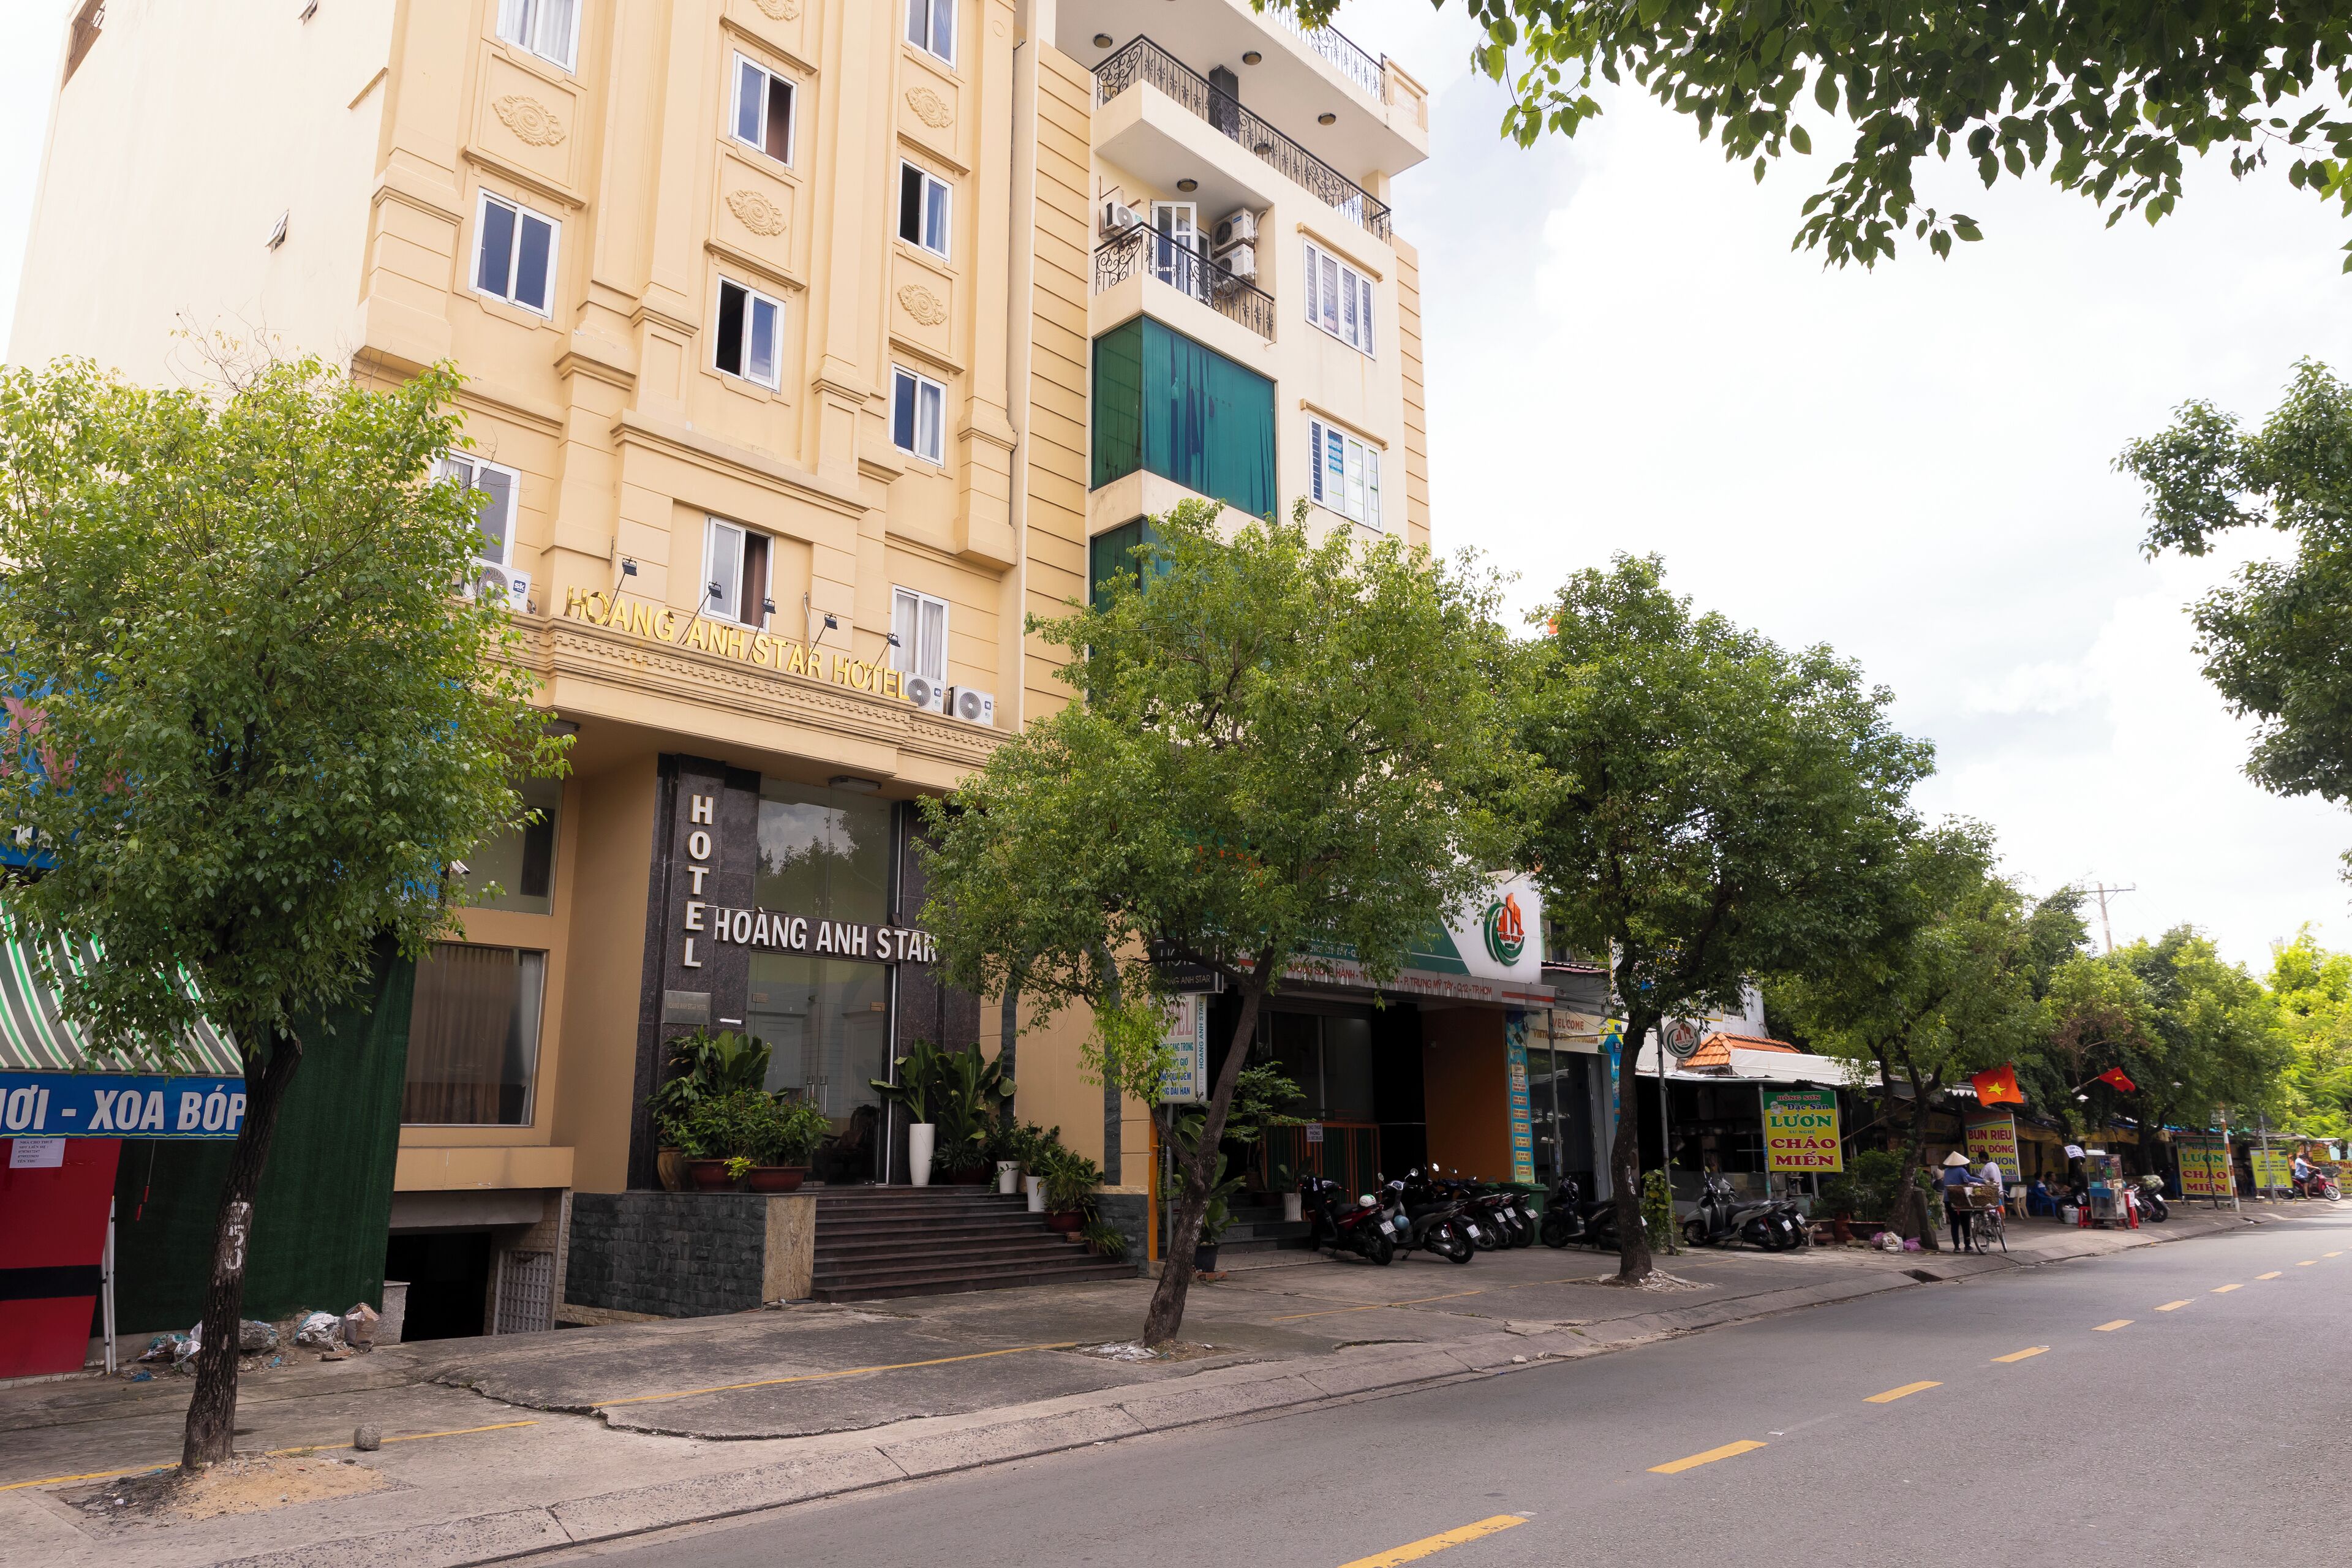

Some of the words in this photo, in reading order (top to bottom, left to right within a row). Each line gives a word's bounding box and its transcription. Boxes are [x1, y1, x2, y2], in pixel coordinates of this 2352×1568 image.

[685, 617, 745, 661] ANH
[751, 633, 824, 679] STAR
[831, 654, 911, 701] HOTEL
[683, 794, 714, 968] HOTEL
[714, 907, 808, 951] HOÀNG
[815, 921, 868, 957] ANH
[1180, 975, 1194, 984] ANH
[1195, 974, 1211, 984] STAR
[0, 1084, 50, 1131] ƠI
[87, 1090, 165, 1131] XOA
[176, 1084, 247, 1131] BÓP
[1770, 1113, 1833, 1128] LƯƠN
[1990, 1128, 2012, 1140] RIÊU
[1770, 1135, 1837, 1150] CHÁO
[1774, 1151, 1834, 1166] MIẾN
